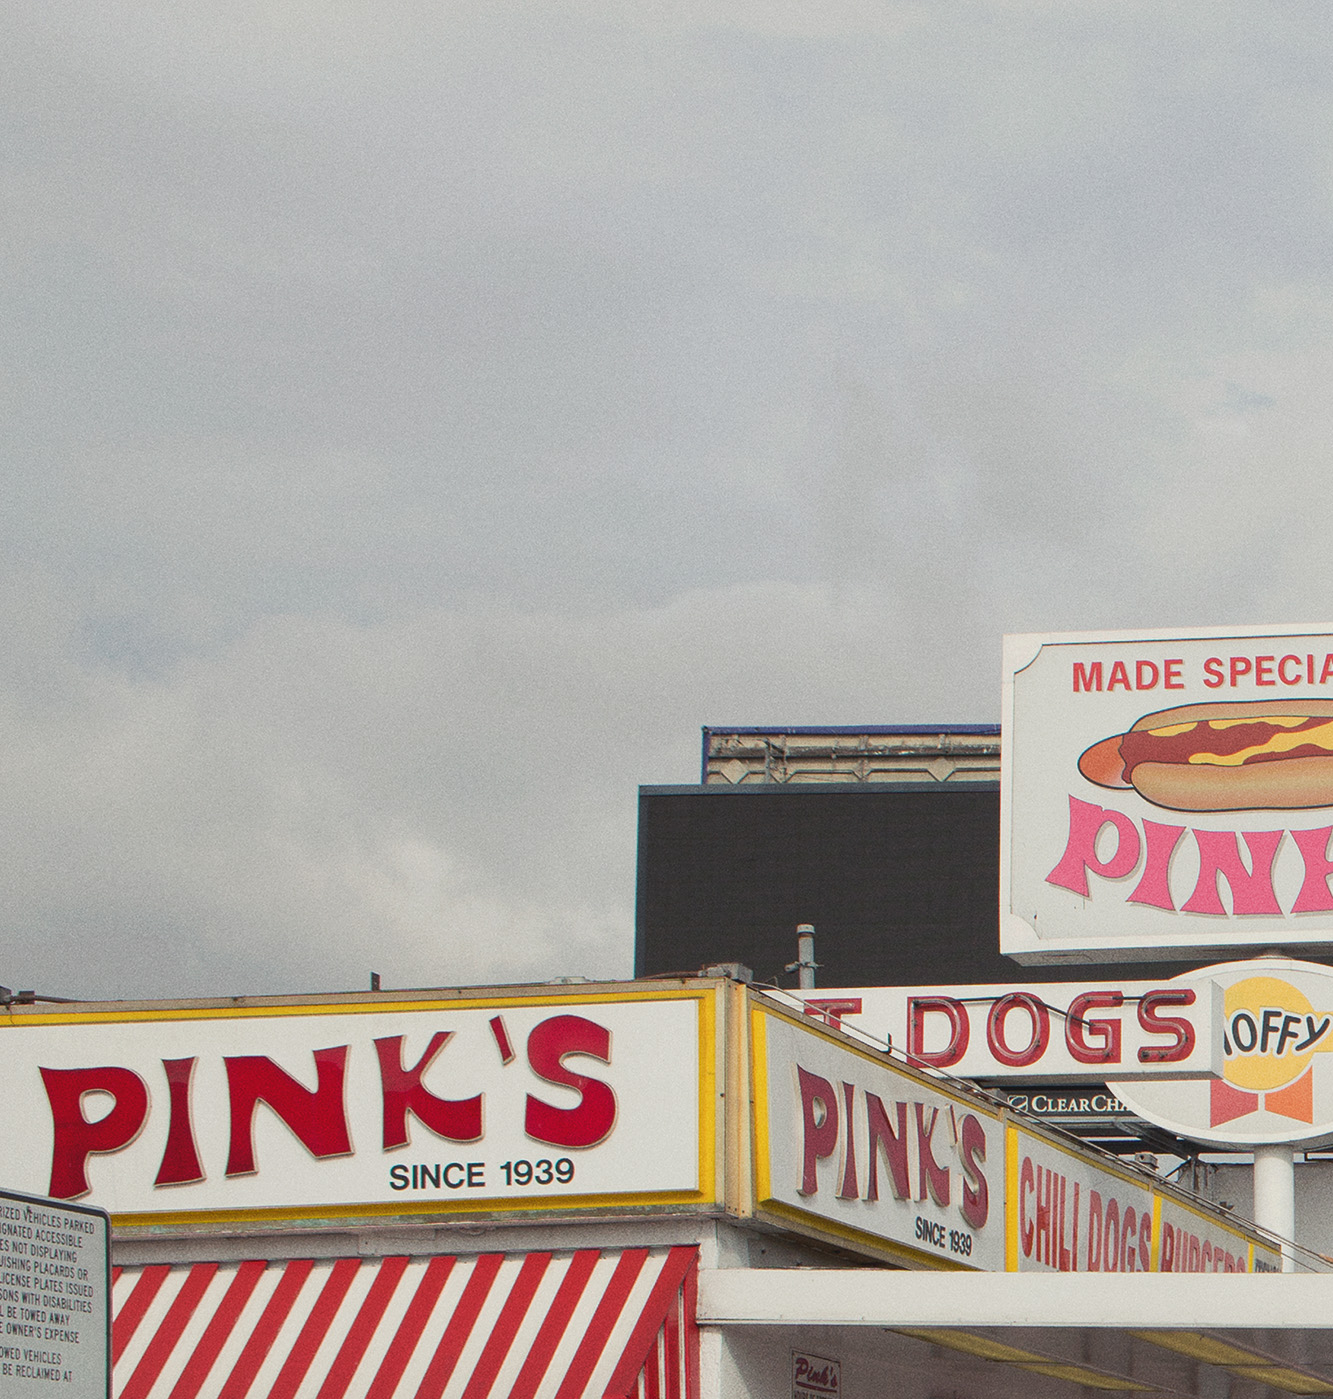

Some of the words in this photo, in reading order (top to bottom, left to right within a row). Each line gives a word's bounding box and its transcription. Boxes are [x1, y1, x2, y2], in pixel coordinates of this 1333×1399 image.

[1072, 660, 1185, 693] MADE
[907, 986, 1196, 1069] DOGS
[39, 1014, 618, 1200] PINK'S
[792, 1062, 988, 1229] PINK'S
[389, 1161, 486, 1191] SINCE
[500, 1158, 575, 1187] 1939
[24, 1210, 62, 1228] VEHICLES
[64, 1218, 94, 1234] PARKED
[1020, 1156, 1080, 1271] CHILI
[36, 1229, 83, 1248] ACCESSIBLE
[915, 1216, 946, 1248] SINCE
[949, 1230, 972, 1256] 1939
[12, 1242, 28, 1254] NOT
[30, 1244, 77, 1263] DISPLAYING
[34, 1261, 75, 1278] PLACARDS
[78, 1268, 88, 1280] OR
[34, 1276, 63, 1293] PLATES
[66, 1282, 94, 1298] ISSUED
[22, 1292, 40, 1306] WITH
[43, 1295, 92, 1313] DISABILITIES
[7, 1306, 17, 1318] BE
[20, 1308, 46, 1322] TOWED
[50, 1312, 70, 1326] AWAY
[6, 1322, 42, 1338] OWNER'S
[44, 1328, 80, 1344] EXPENSE
[24, 1349, 62, 1364] VEHICLES
[2, 1363, 12, 1376] BE
[16, 1364, 60, 1381] RECLAIMED
[63, 1370, 72, 1382] AT
